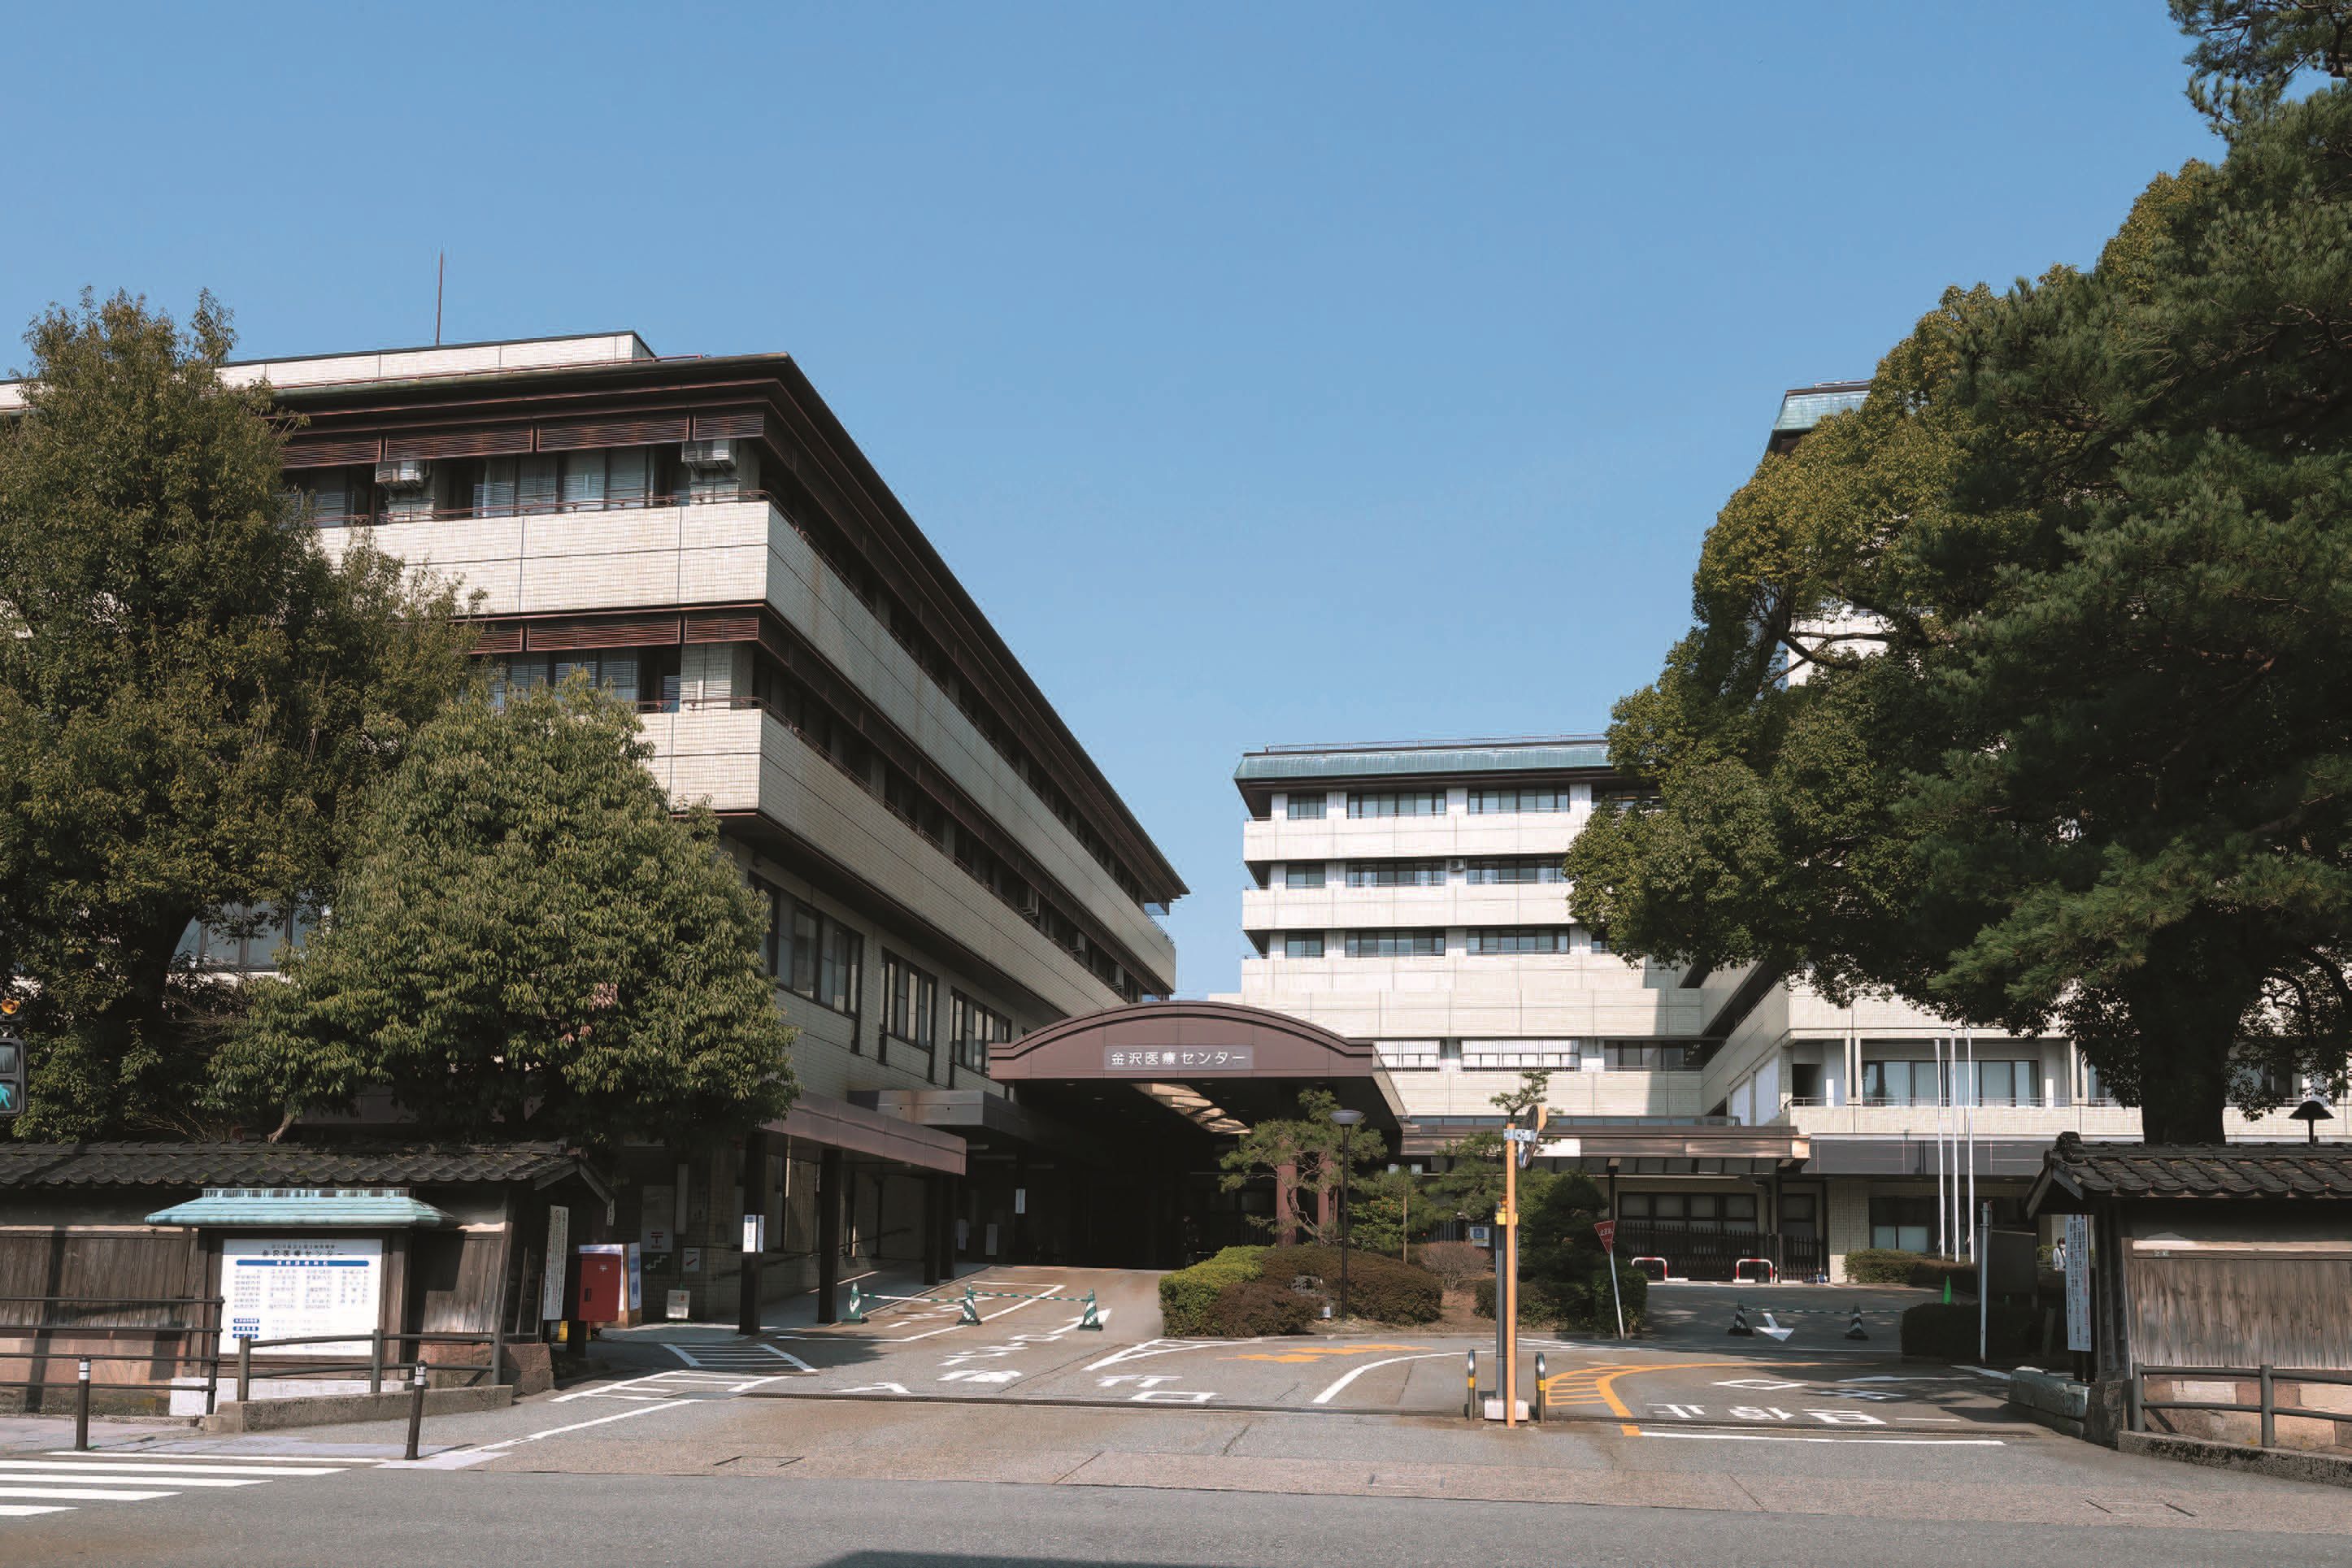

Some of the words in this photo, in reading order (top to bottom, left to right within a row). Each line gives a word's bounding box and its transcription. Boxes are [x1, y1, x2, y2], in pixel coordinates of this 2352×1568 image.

[1111, 1051, 1246, 1066] 金沢医療センター
